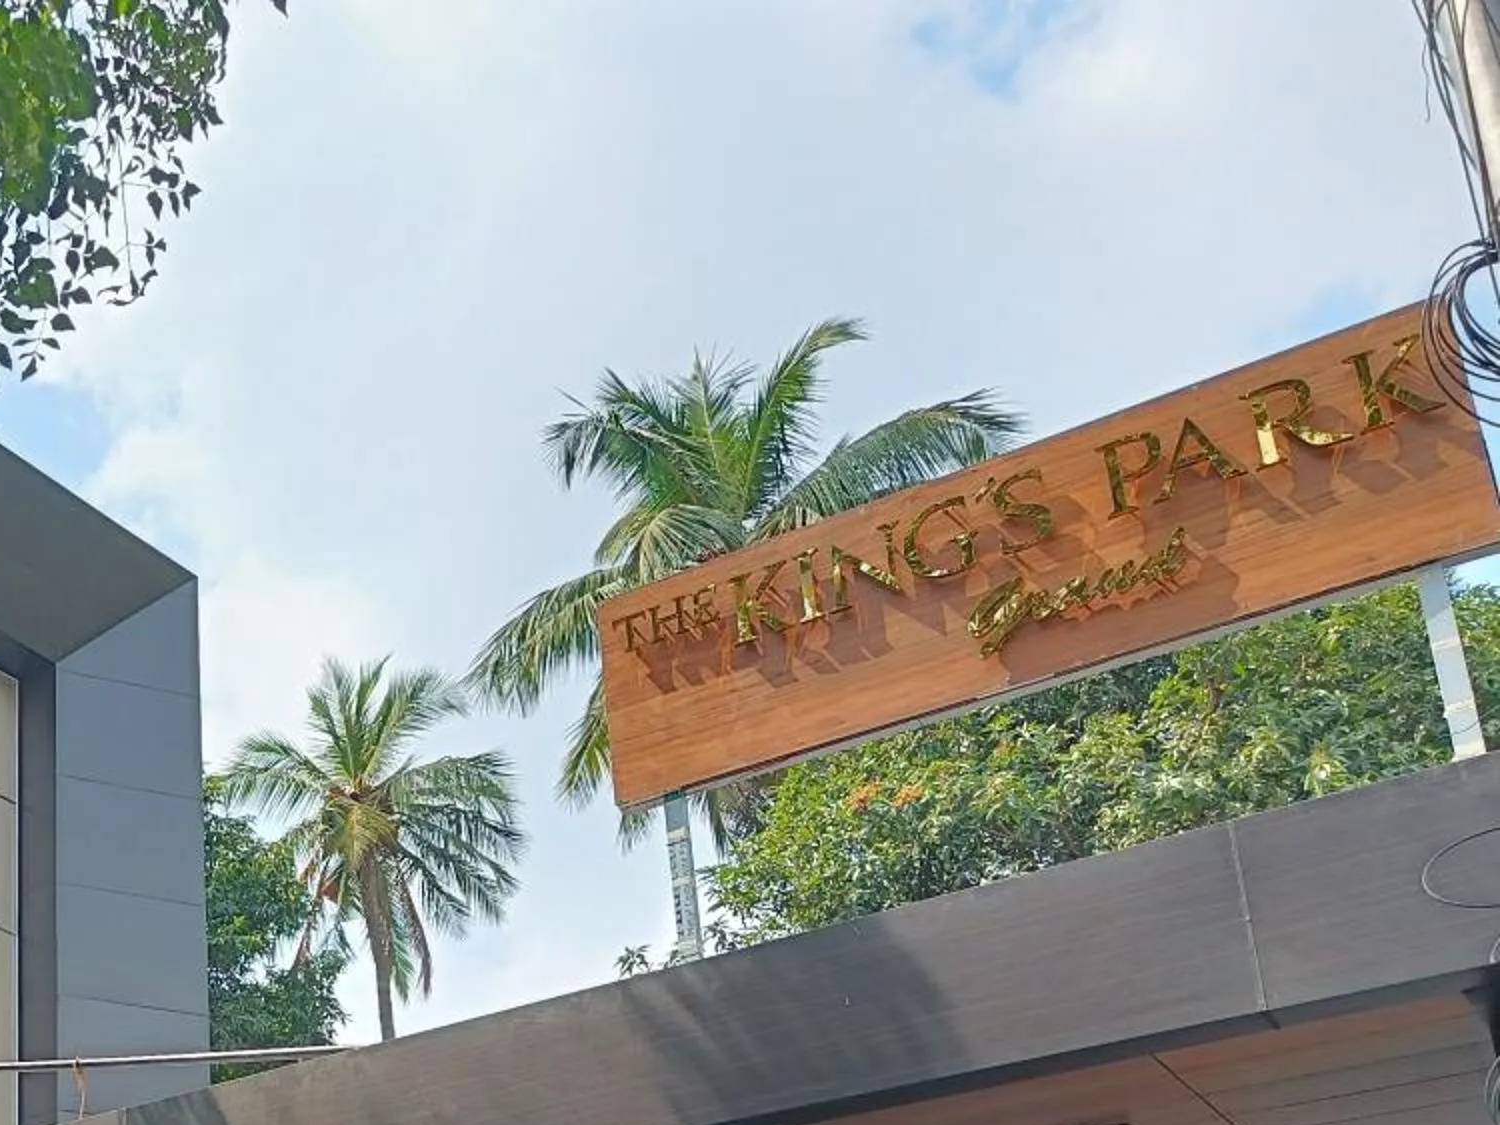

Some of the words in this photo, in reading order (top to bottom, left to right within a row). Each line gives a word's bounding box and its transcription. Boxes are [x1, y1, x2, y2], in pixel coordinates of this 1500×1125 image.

[611, 583, 720, 653] THE
[727, 467, 1054, 647] KING'S
[1094, 332, 1447, 521] PARK
